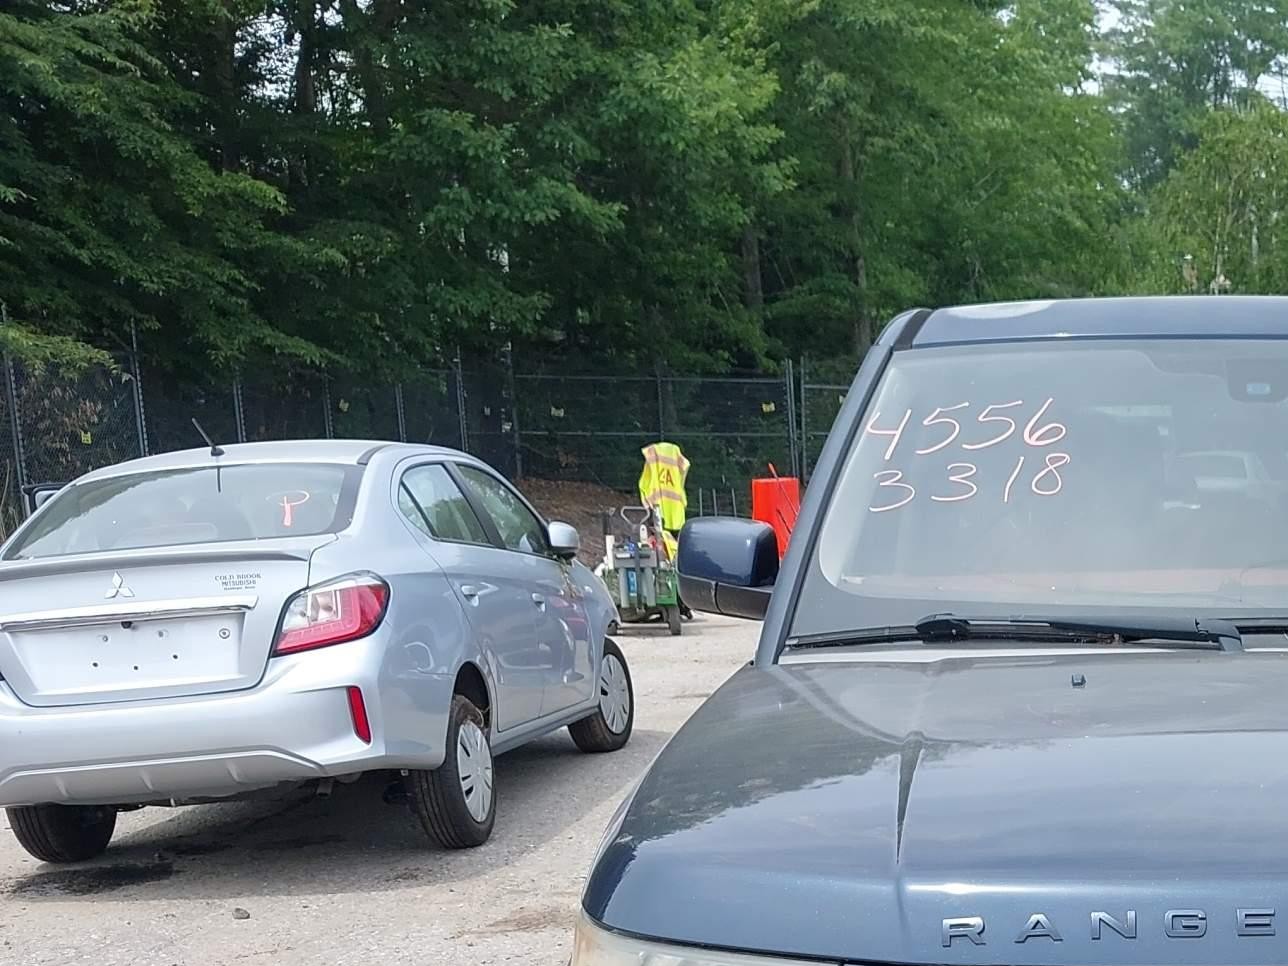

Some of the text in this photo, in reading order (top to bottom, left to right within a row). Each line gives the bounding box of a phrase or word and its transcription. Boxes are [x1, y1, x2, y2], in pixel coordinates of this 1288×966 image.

[866, 397, 1066, 460] 4556
[868, 453, 1071, 512] 3318
[941, 908, 1277, 948] RANGE
